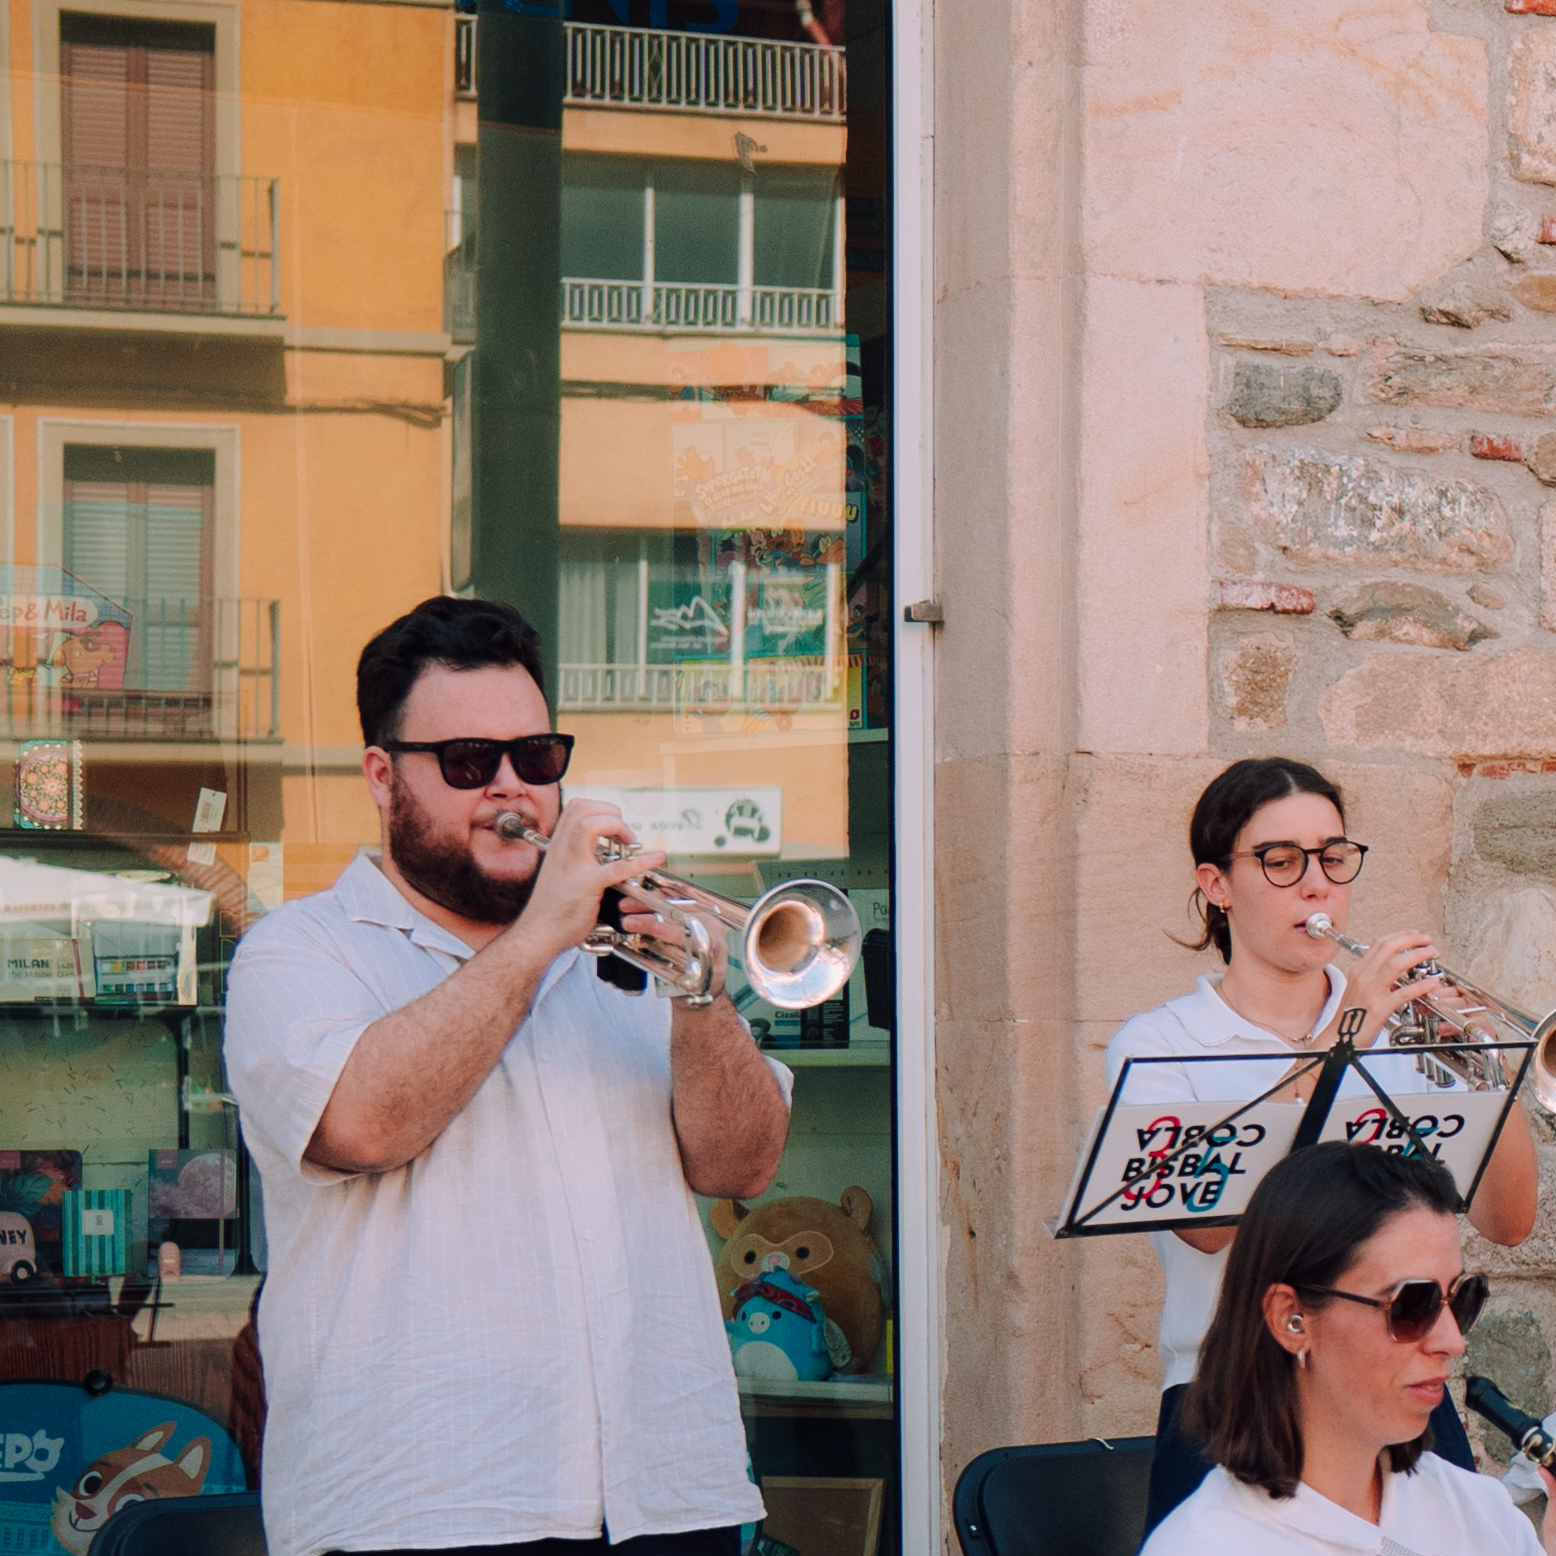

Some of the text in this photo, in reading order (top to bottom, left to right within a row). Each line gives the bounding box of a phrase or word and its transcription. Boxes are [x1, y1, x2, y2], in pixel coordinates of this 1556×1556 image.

[44, 600, 87, 623] Mila
[8, 959, 49, 969] MILAN
[1136, 1122, 1266, 1152] COBLA
[1345, 1114, 1465, 1145] COBLA
[1121, 1153, 1247, 1182] BISBAL
[1120, 1180, 1223, 1211] JOVE
